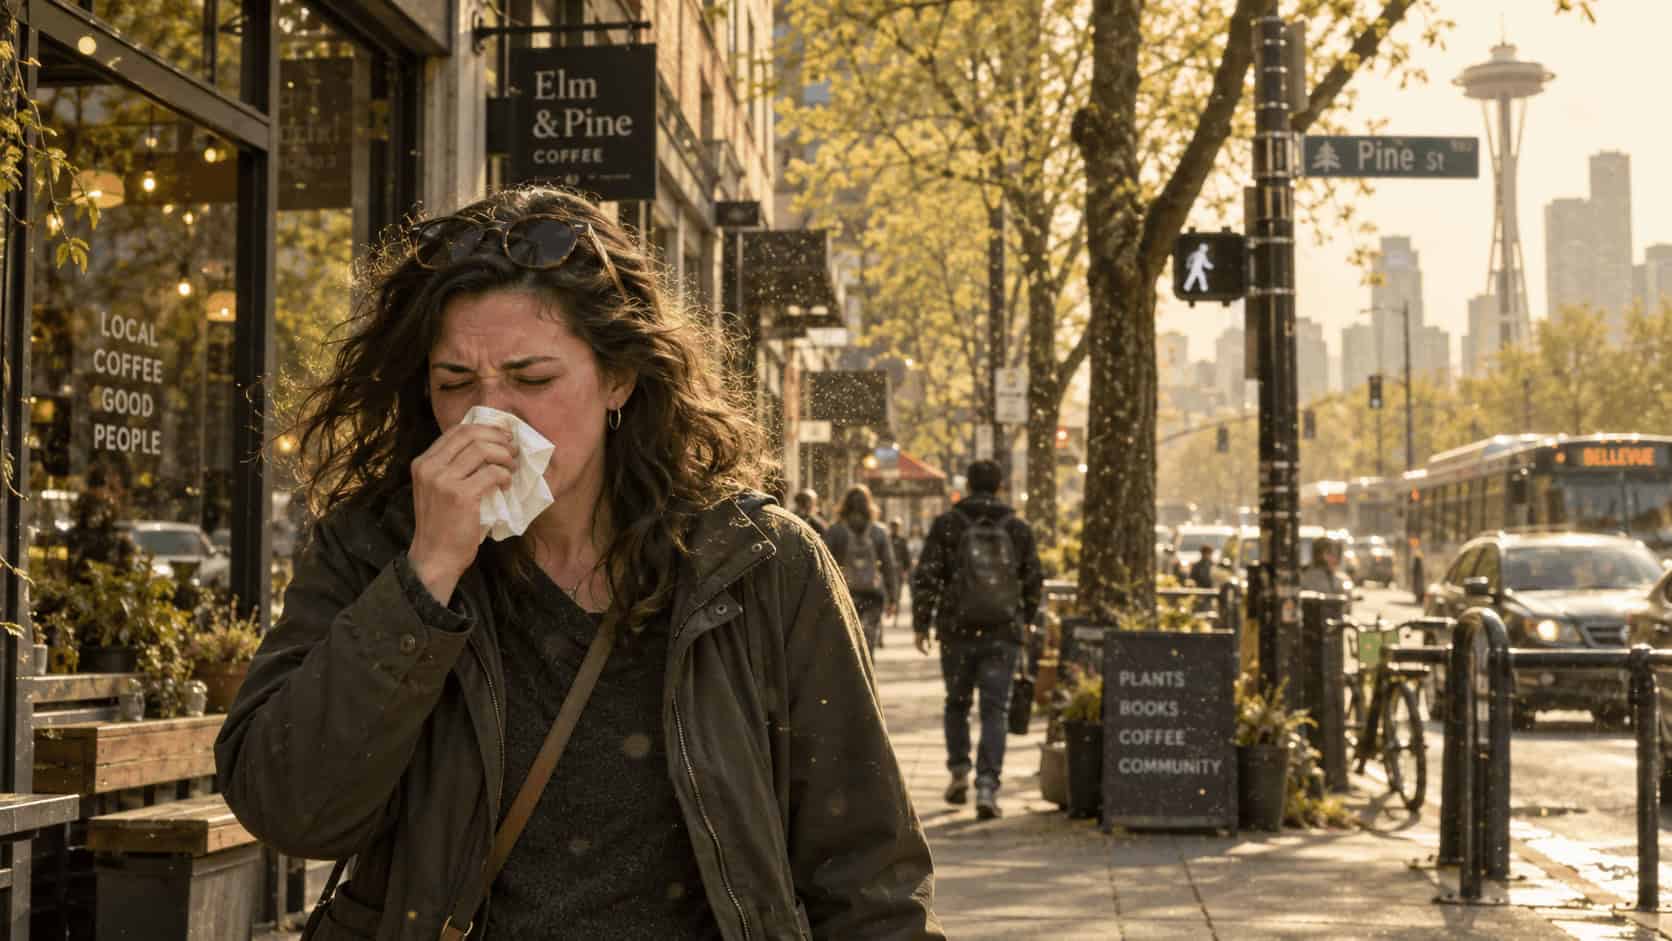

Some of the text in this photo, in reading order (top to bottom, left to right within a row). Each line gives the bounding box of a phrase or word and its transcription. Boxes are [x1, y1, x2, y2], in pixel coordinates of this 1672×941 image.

[535, 68, 599, 100] Elm
[532, 107, 634, 139] & Pine
[532, 148, 605, 164] COFFEE
[1358, 140, 1414, 172] Pine
[101, 311, 159, 348] LOCAL
[94, 348, 164, 384] COFFEE
[102, 387, 154, 417] GOOD
[94, 423, 161, 455] PEOPLE
[1119, 671, 1185, 688] PLANTS
[1119, 701, 1179, 717] BOOKS
[1119, 729, 1187, 746] COFFEE
[1118, 757, 1223, 775] COMMUNITY
